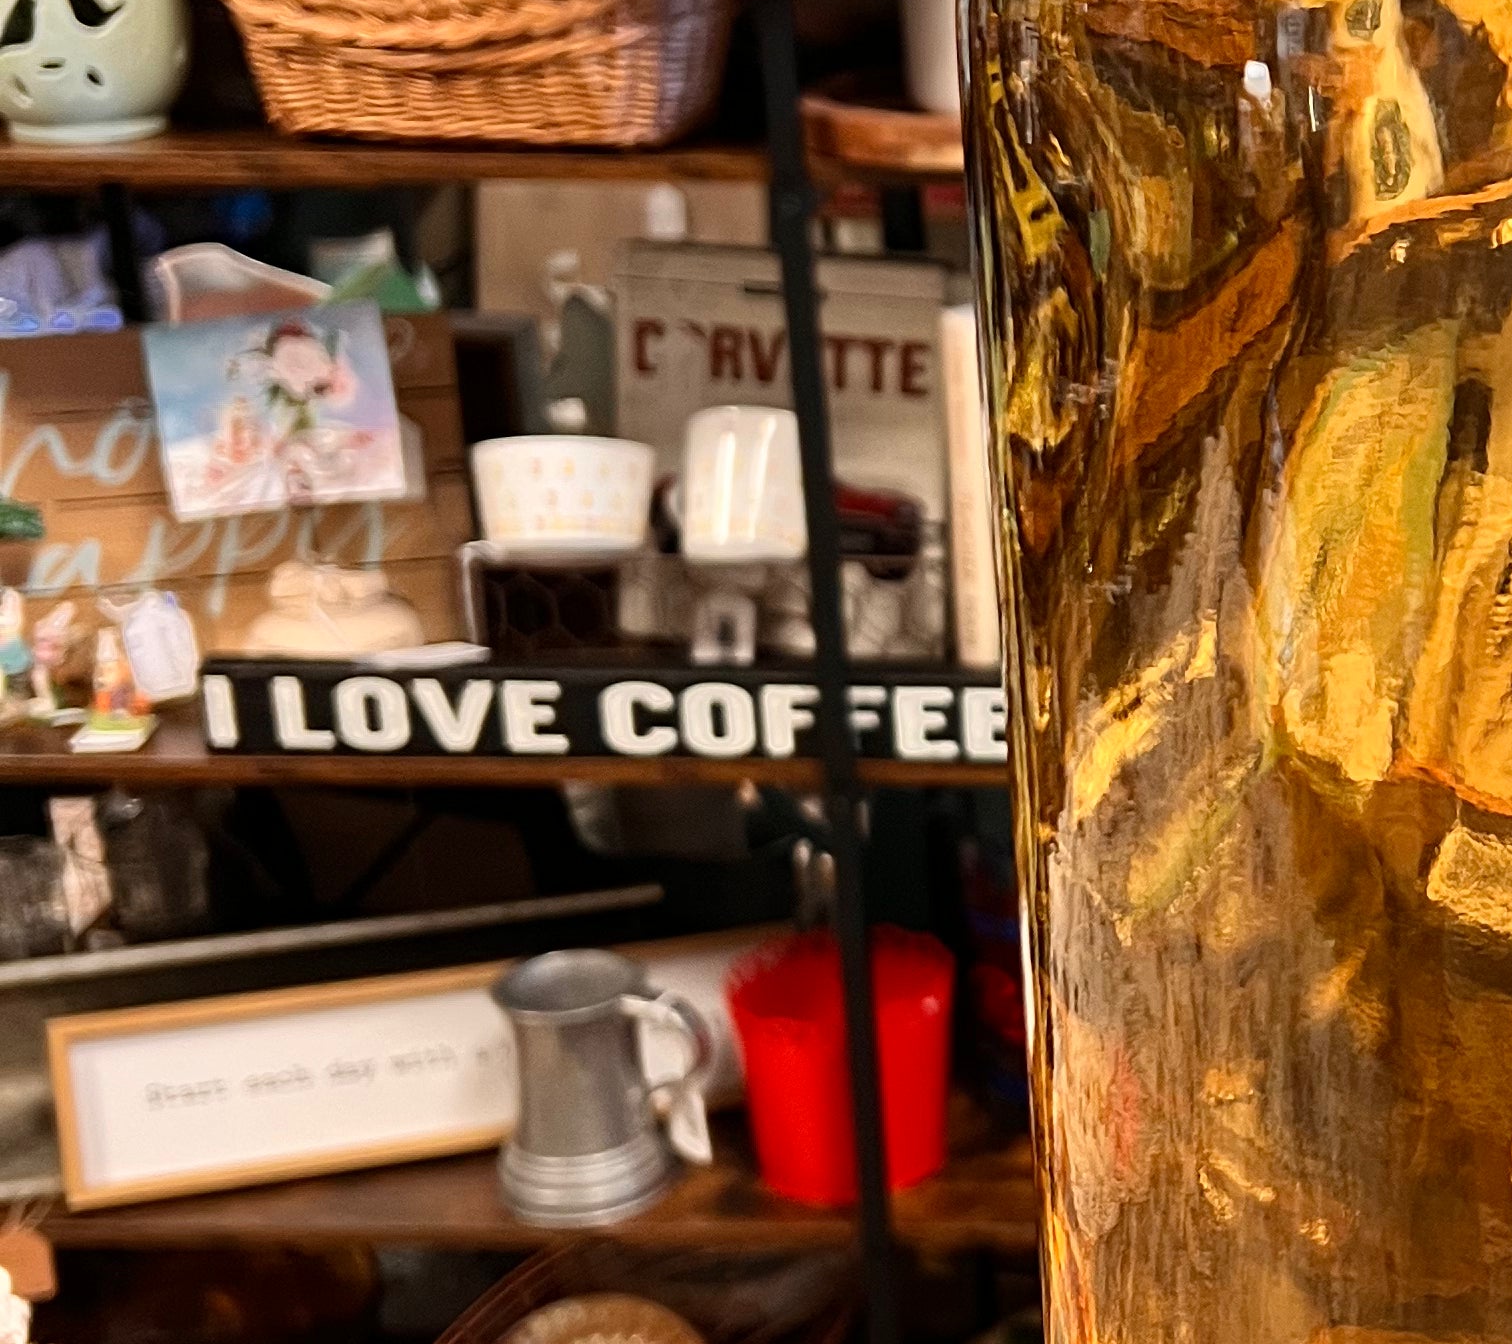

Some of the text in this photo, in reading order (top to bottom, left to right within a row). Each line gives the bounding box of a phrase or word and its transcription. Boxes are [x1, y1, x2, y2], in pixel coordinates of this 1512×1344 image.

[632, 316, 930, 399] CRVTTE
[204, 673, 240, 749] I
[269, 674, 571, 756] LOVE
